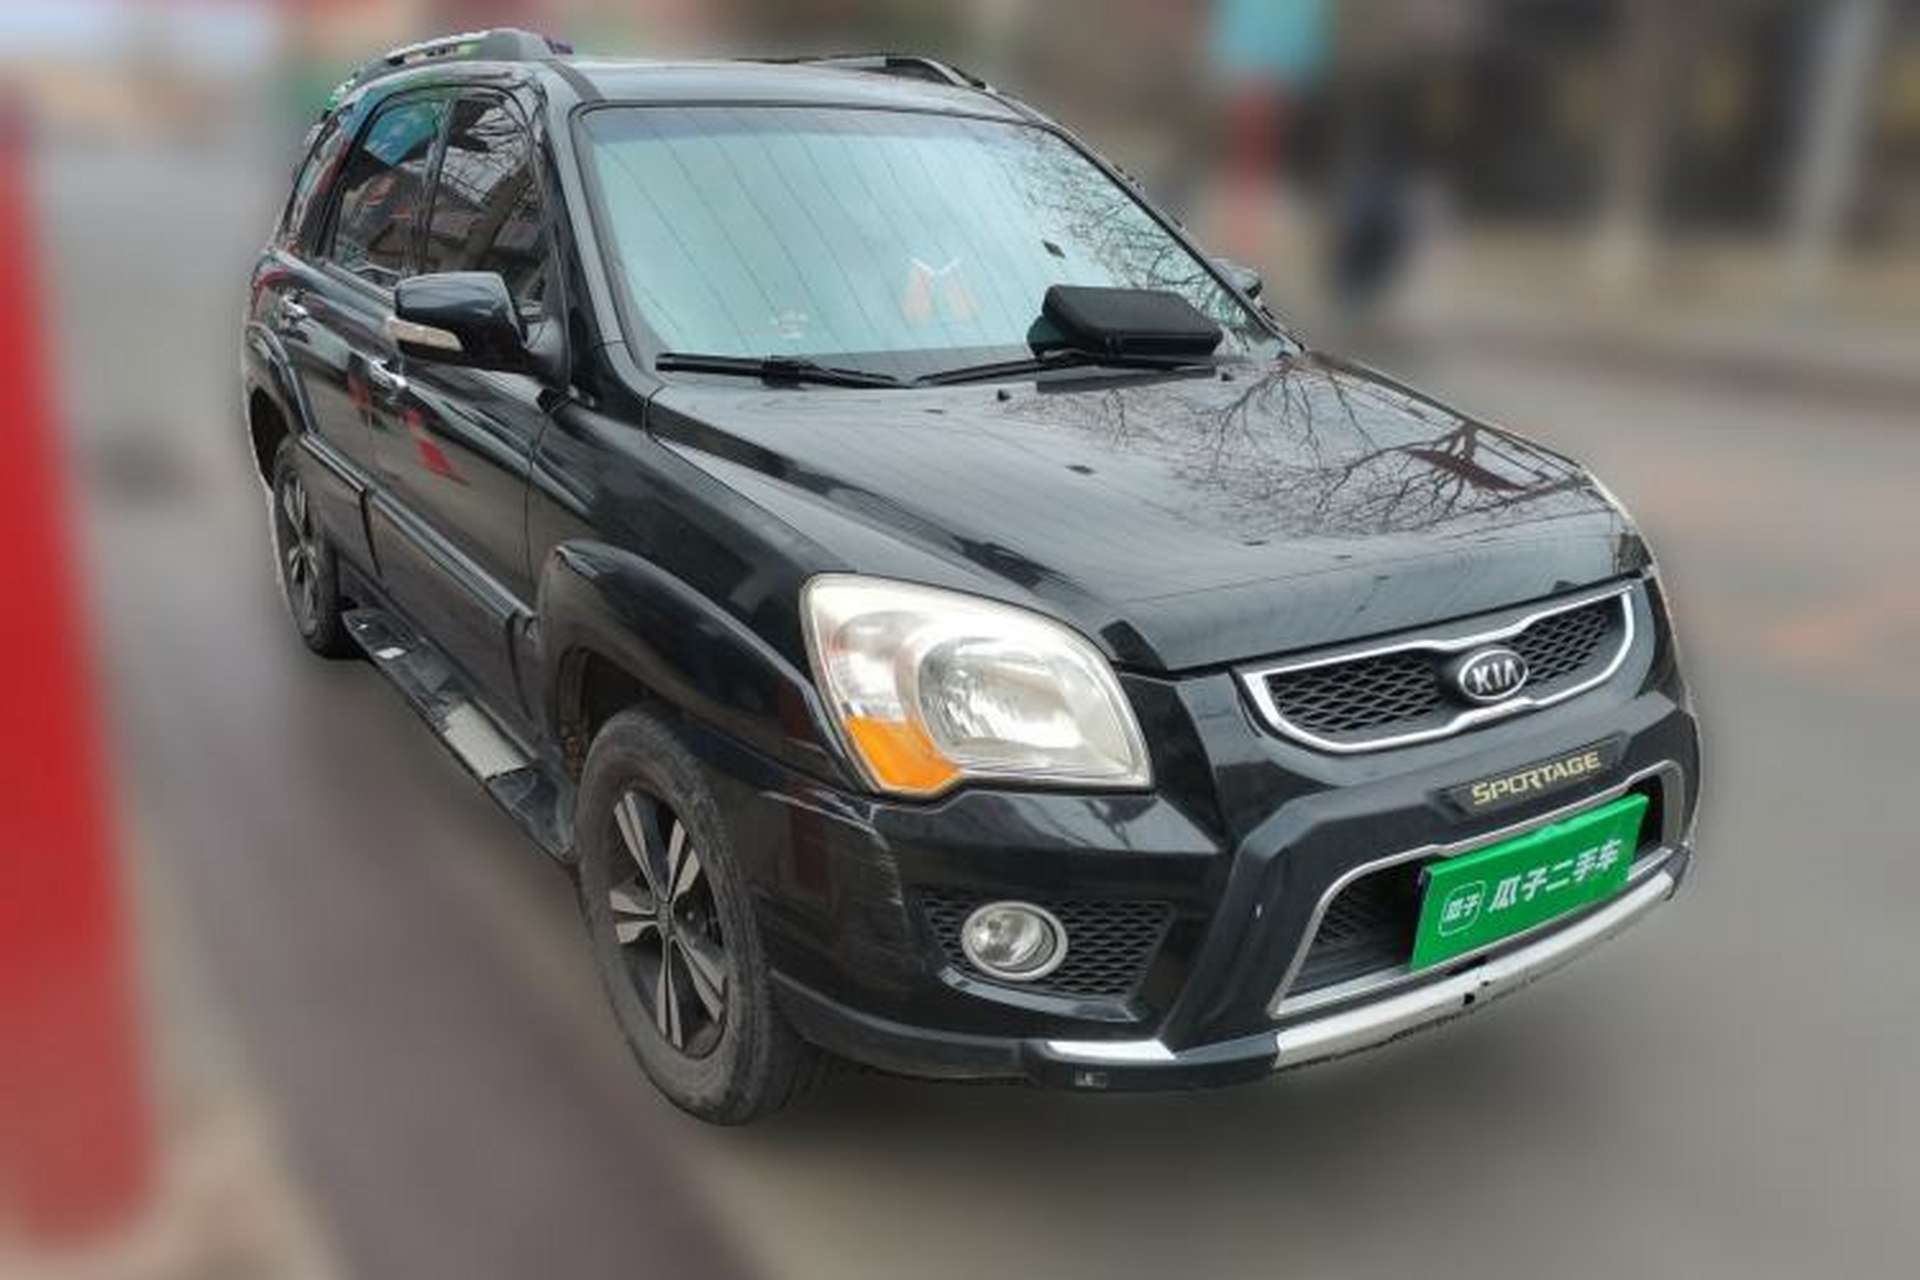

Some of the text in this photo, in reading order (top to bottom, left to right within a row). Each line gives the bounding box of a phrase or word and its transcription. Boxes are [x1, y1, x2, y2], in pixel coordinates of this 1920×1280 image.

[1472, 660, 1519, 694] KIA
[1471, 751, 1600, 805] SPORTAGE
[1488, 839, 1622, 913] 瓜子二手车
